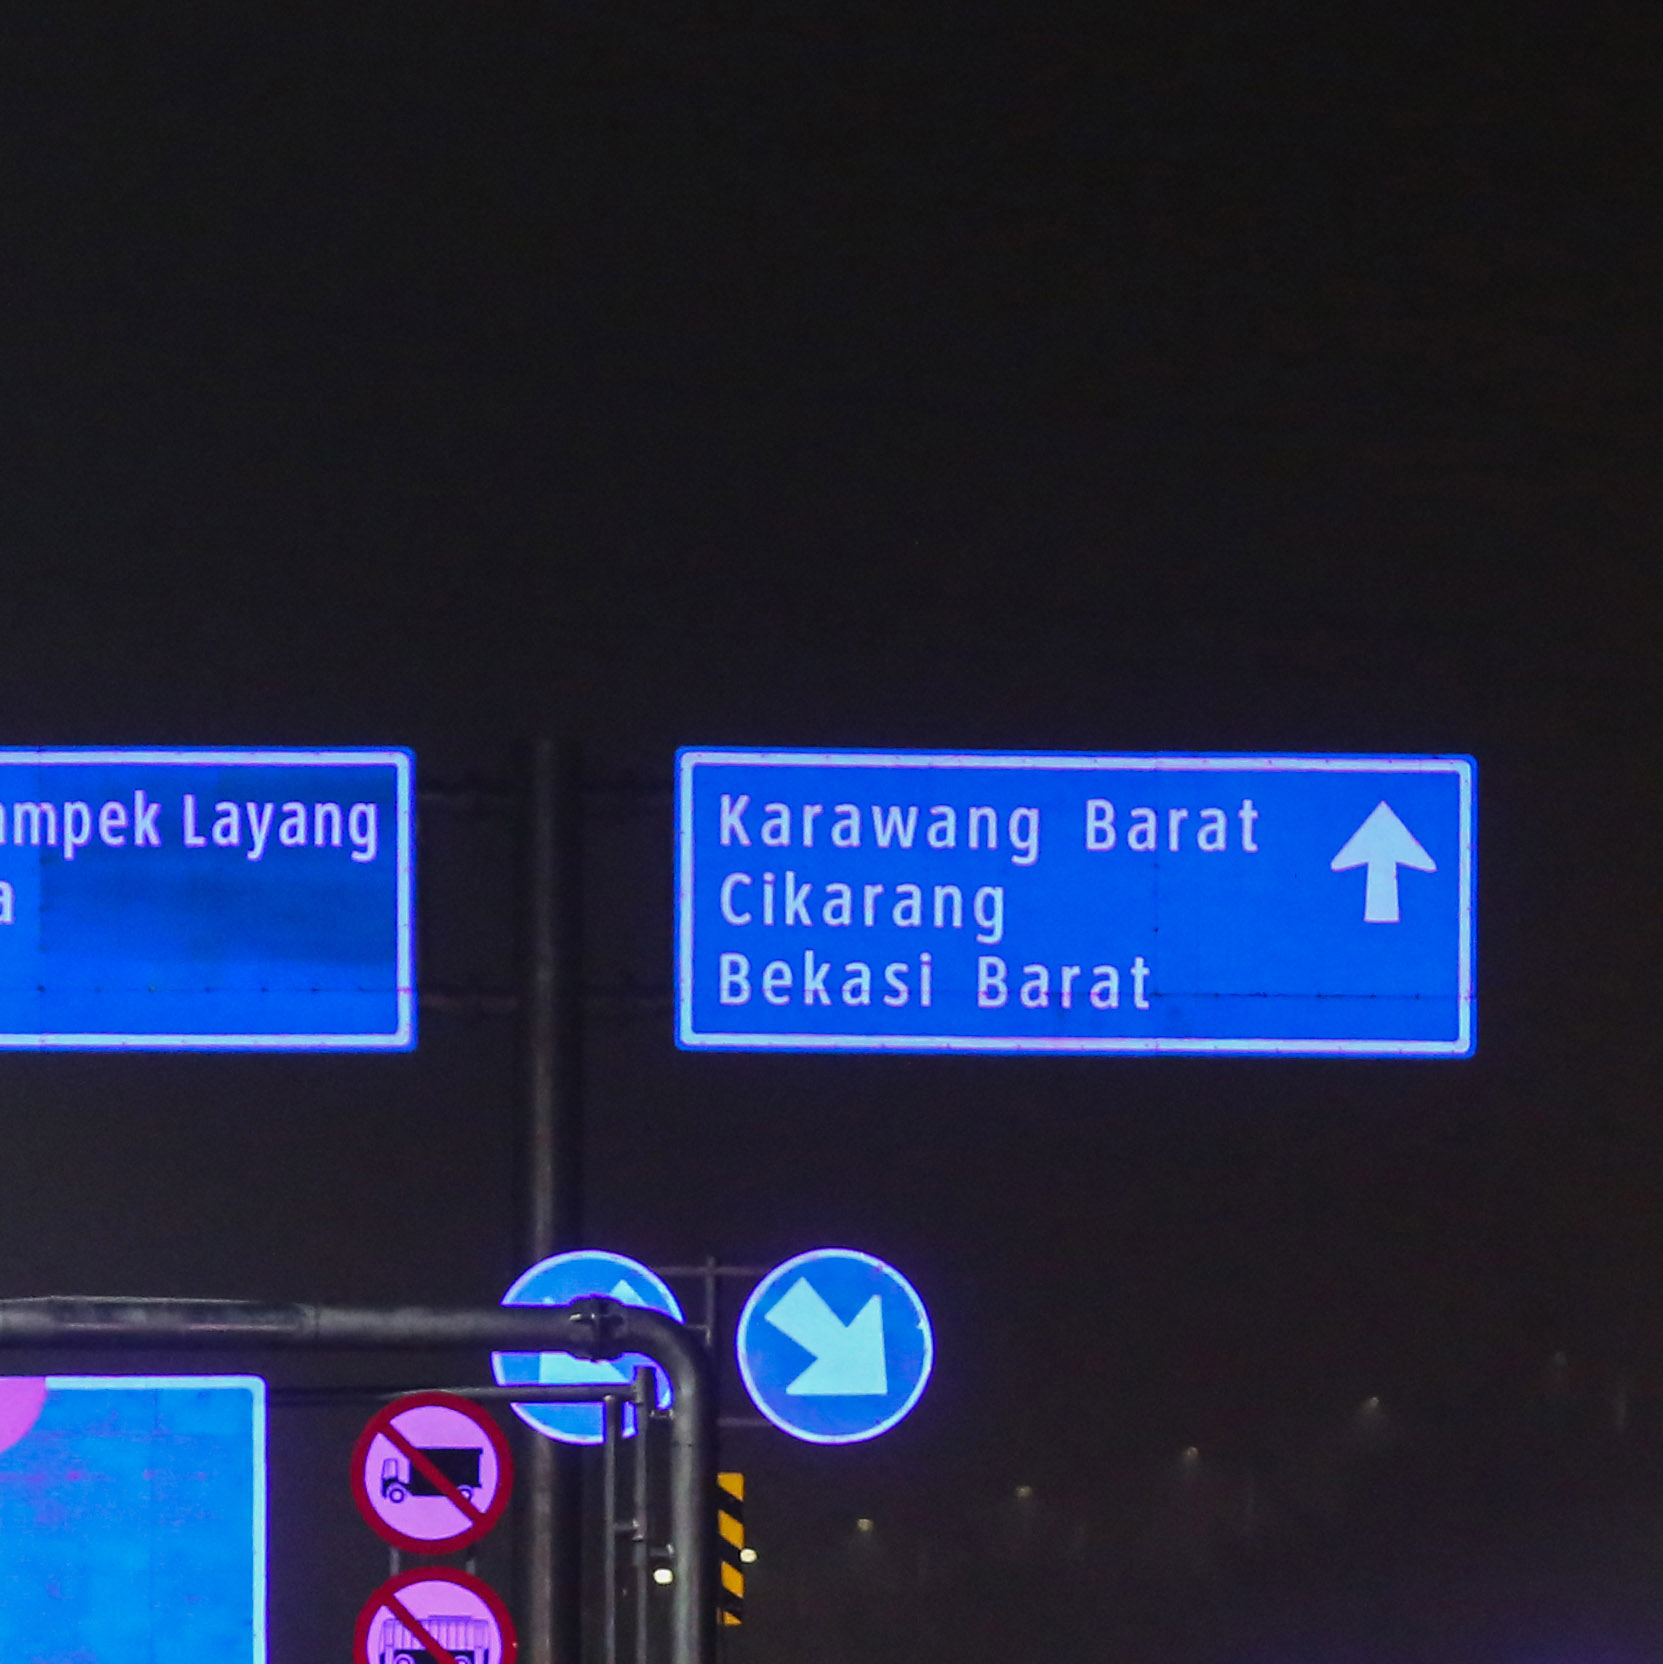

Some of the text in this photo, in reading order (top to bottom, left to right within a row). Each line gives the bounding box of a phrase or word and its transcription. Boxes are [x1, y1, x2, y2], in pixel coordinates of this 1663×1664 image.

[182, 794, 380, 862] Layang
[719, 794, 1260, 867] Karawang Barat
[719, 871, 1006, 944] Cikarang
[719, 950, 1151, 1010] Bekasi Barat
